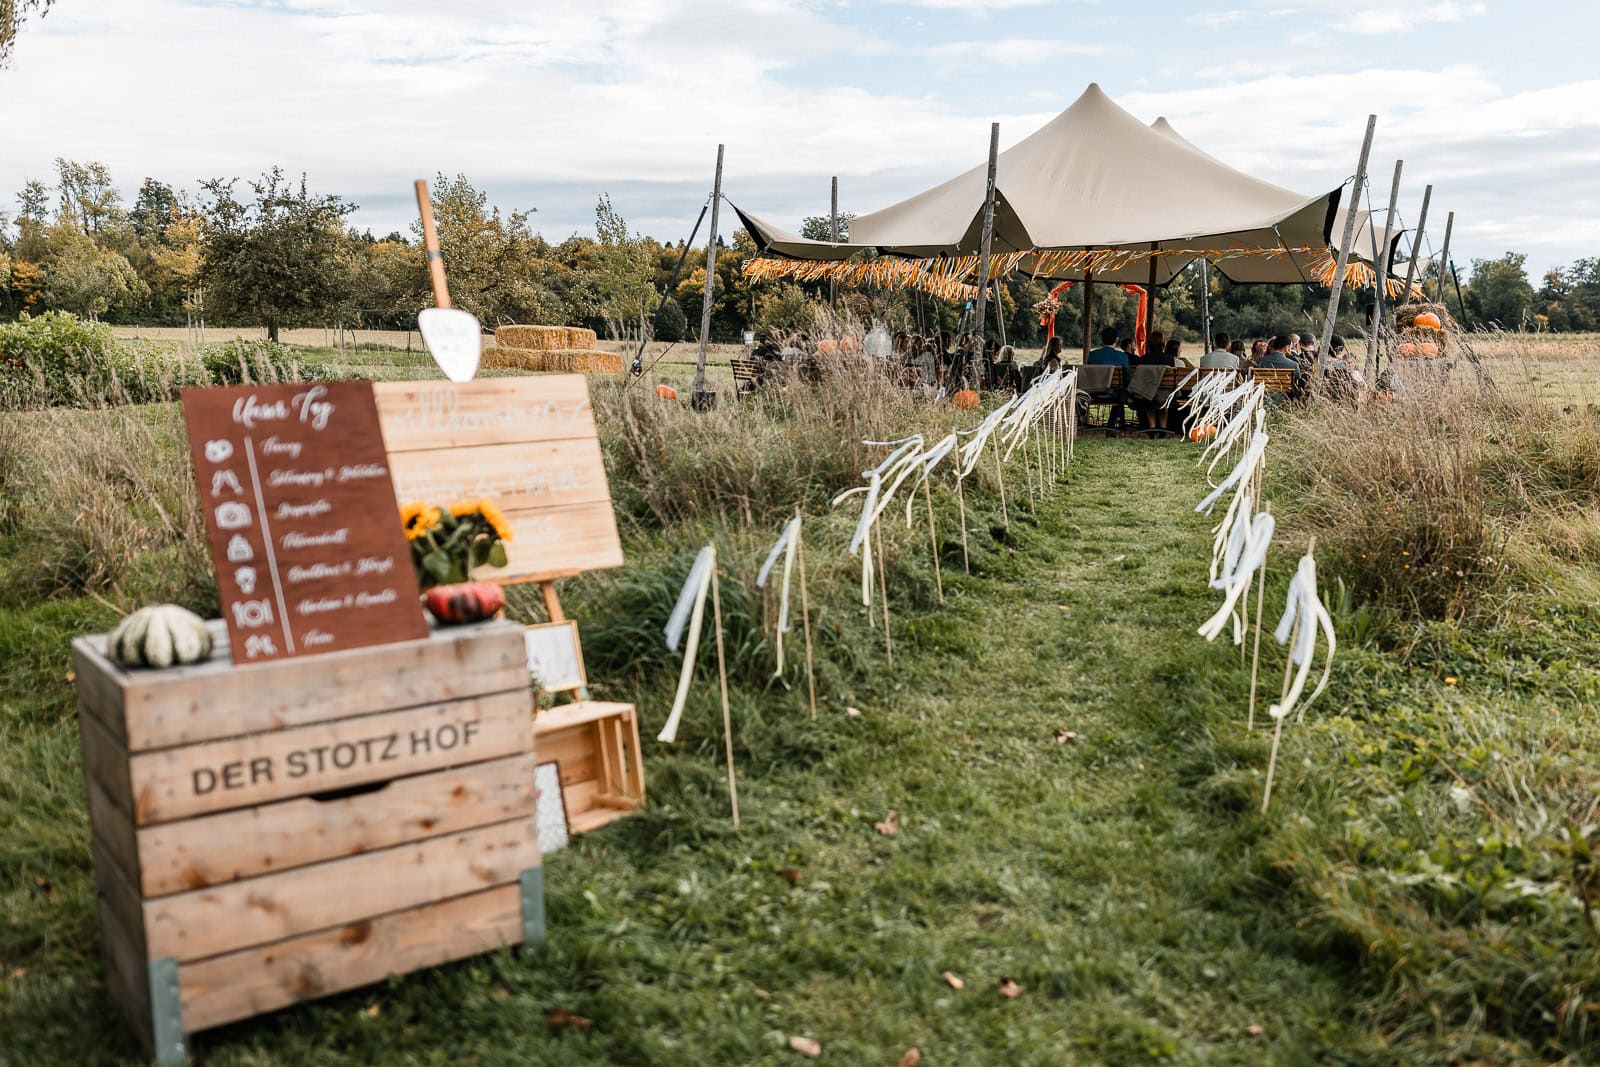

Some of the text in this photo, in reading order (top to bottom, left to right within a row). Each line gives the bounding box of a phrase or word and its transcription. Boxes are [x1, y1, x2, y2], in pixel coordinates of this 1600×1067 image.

[191, 719, 481, 796] DER STOTZ HOF
